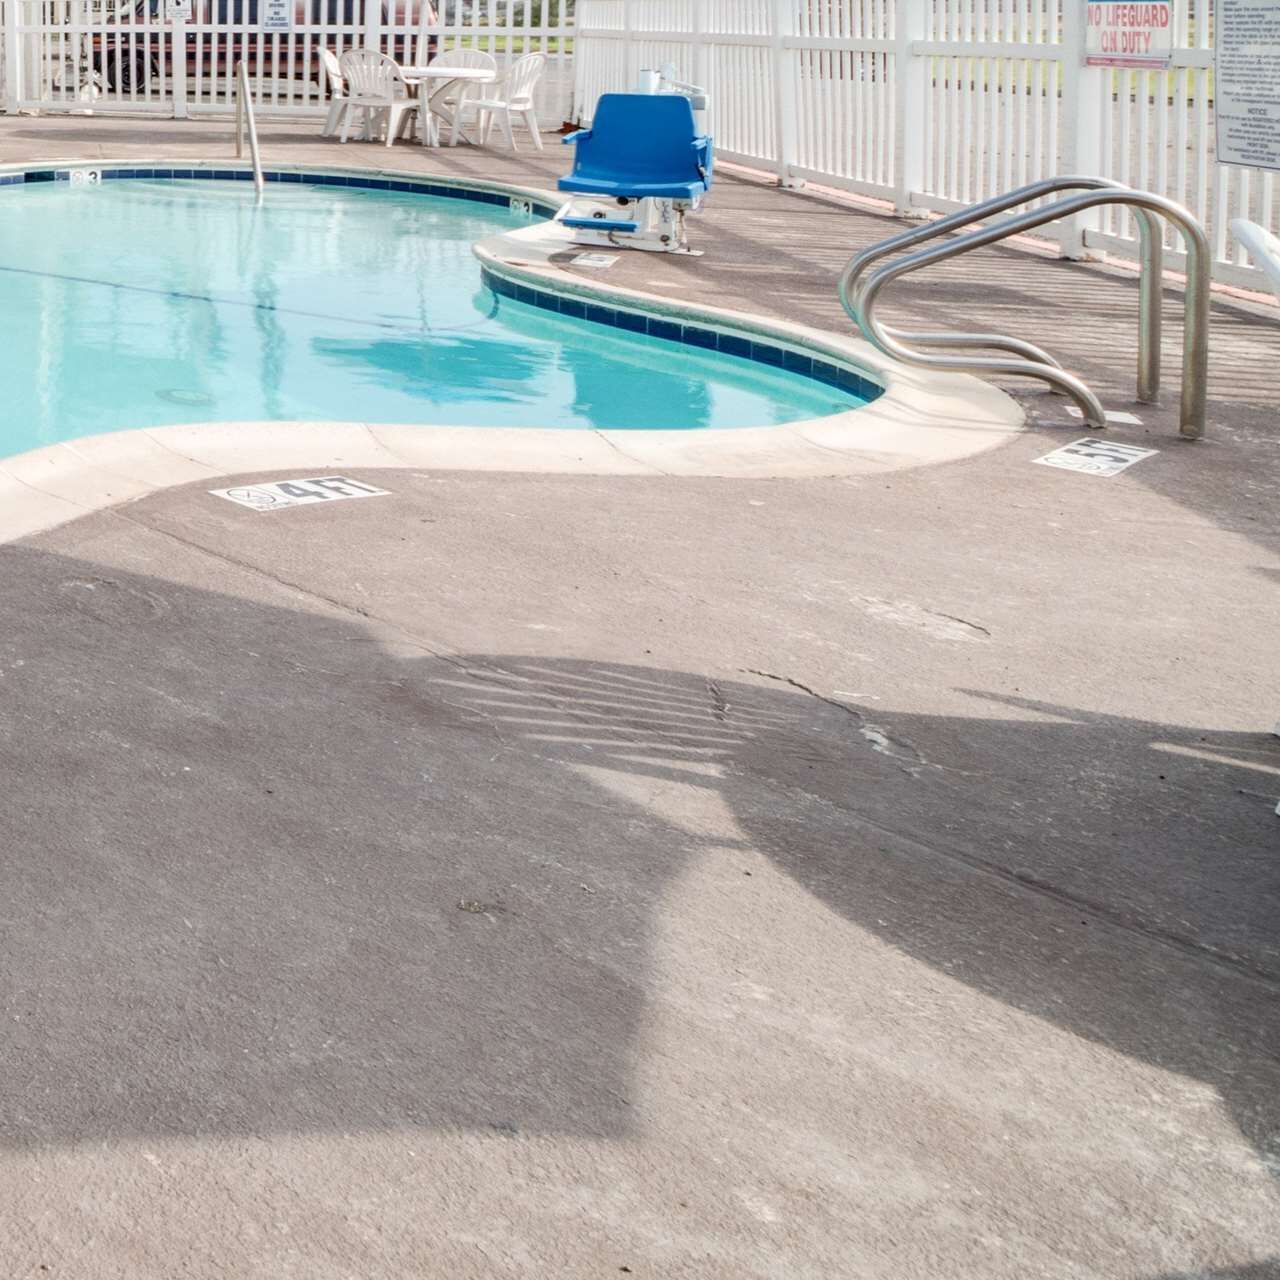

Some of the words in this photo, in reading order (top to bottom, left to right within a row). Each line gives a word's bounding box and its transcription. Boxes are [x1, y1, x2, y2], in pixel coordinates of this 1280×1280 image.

[1088, 5, 1102, 27] NO
[1106, 4, 1169, 28] LIFEGUARD
[1101, 31, 1117, 53] ON
[1121, 31, 1152, 54] DUTY
[275, 482, 331, 499] 4
